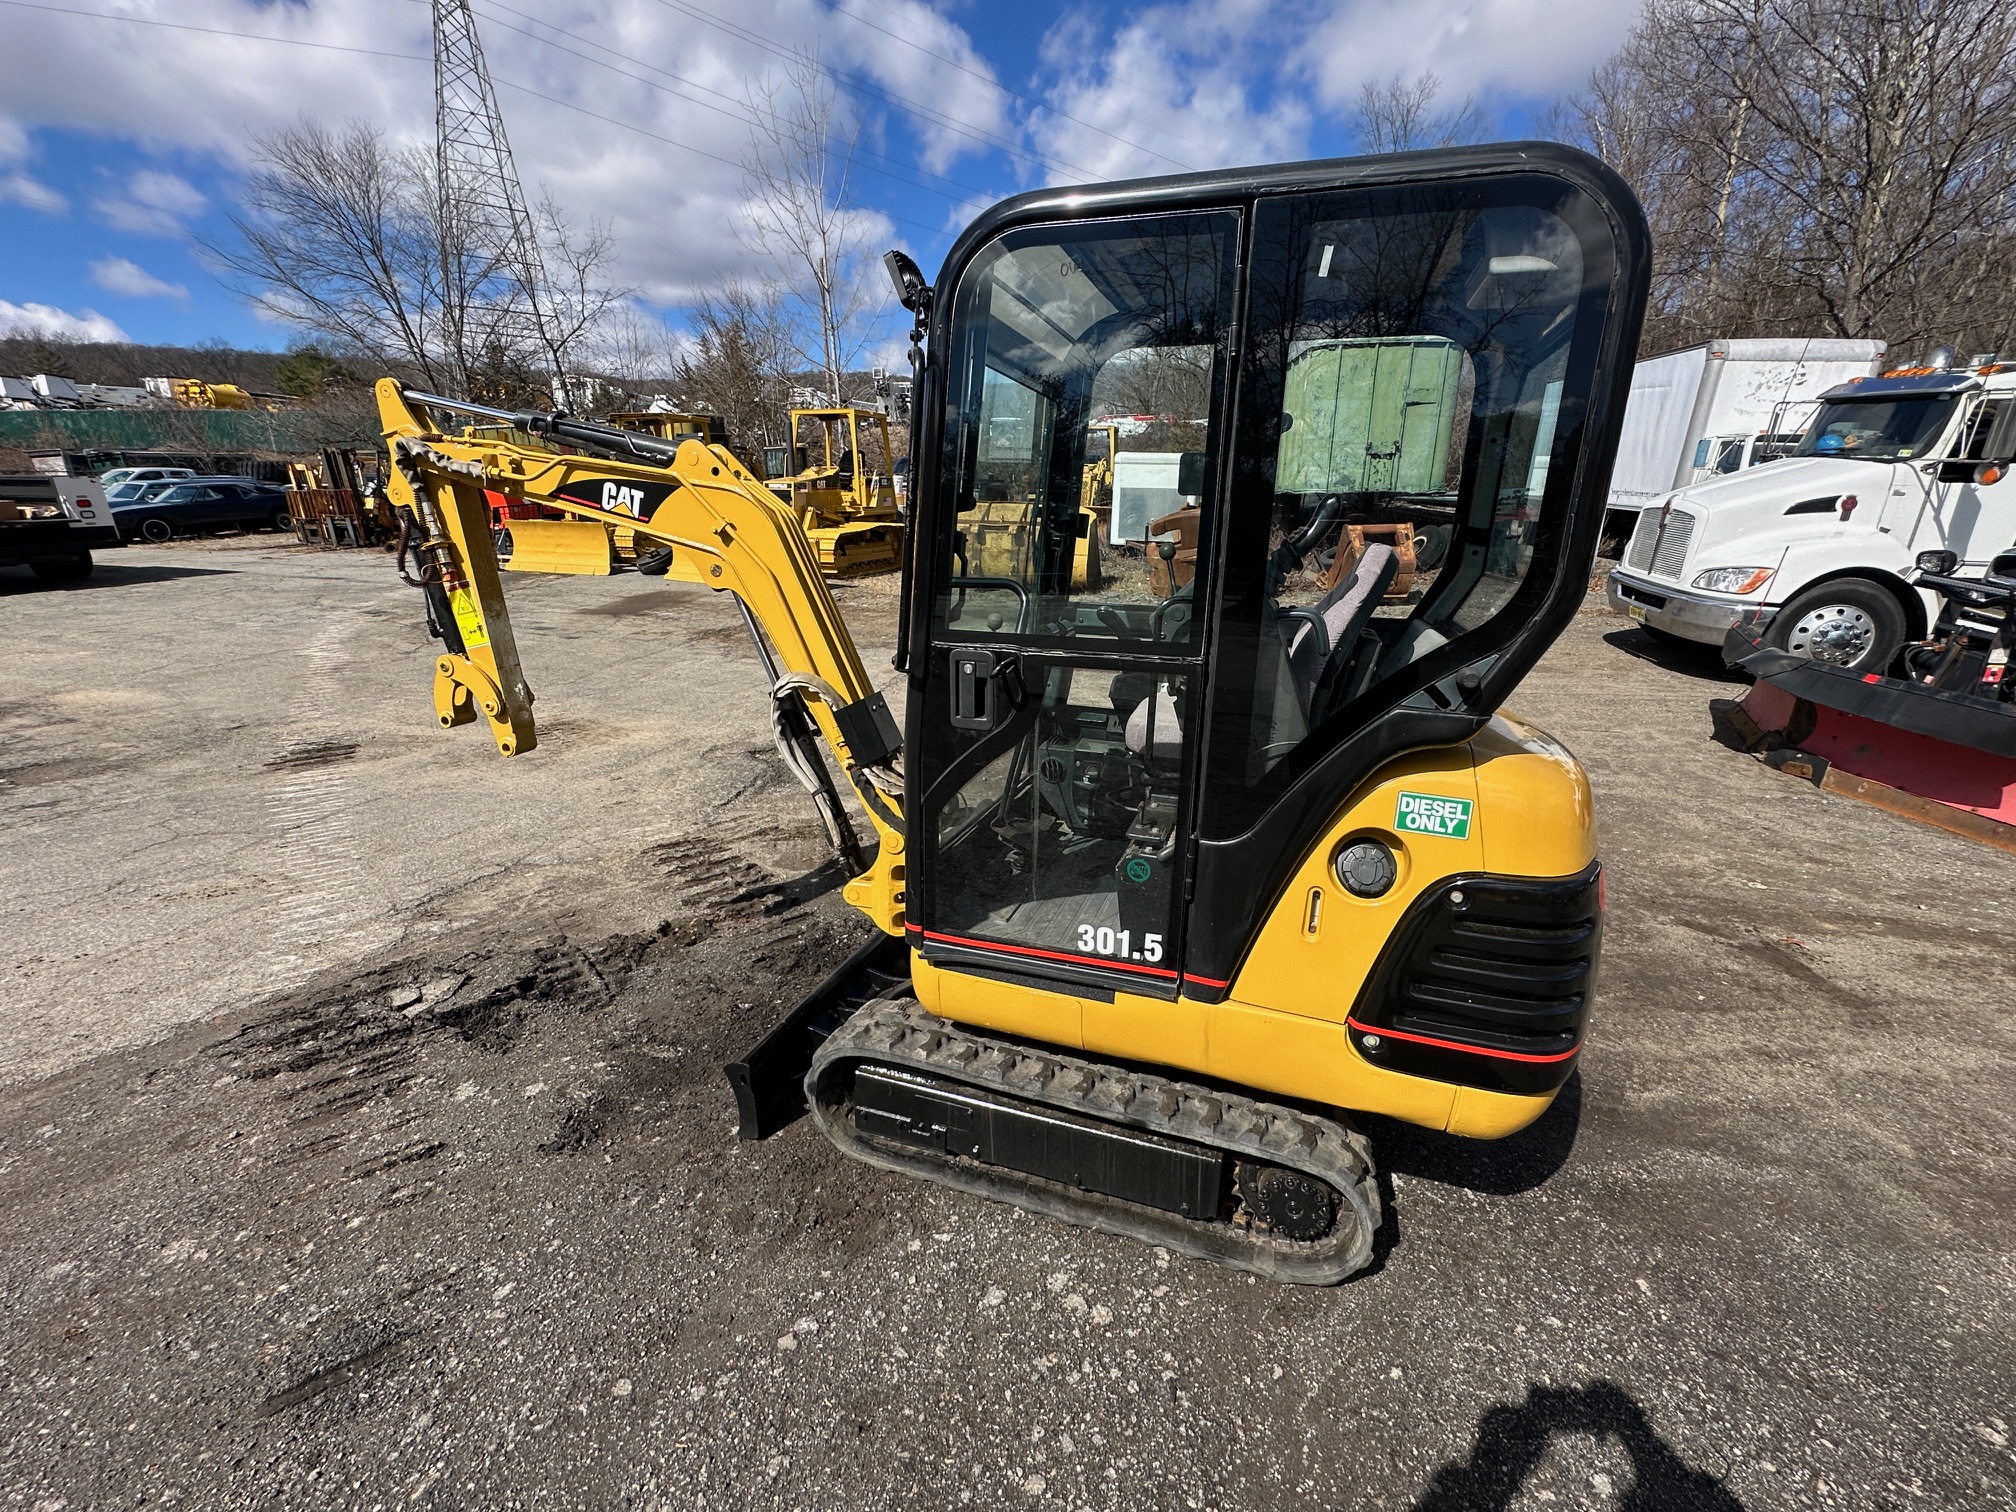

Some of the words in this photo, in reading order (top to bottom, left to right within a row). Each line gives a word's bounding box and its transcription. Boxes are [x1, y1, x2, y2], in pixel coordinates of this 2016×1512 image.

[816, 480, 826, 490] CAT
[601, 481, 645, 519] CAT
[1400, 796, 1468, 820] DIESEL
[1405, 813, 1460, 834] ONLY
[1077, 923, 1164, 963] 301.5
